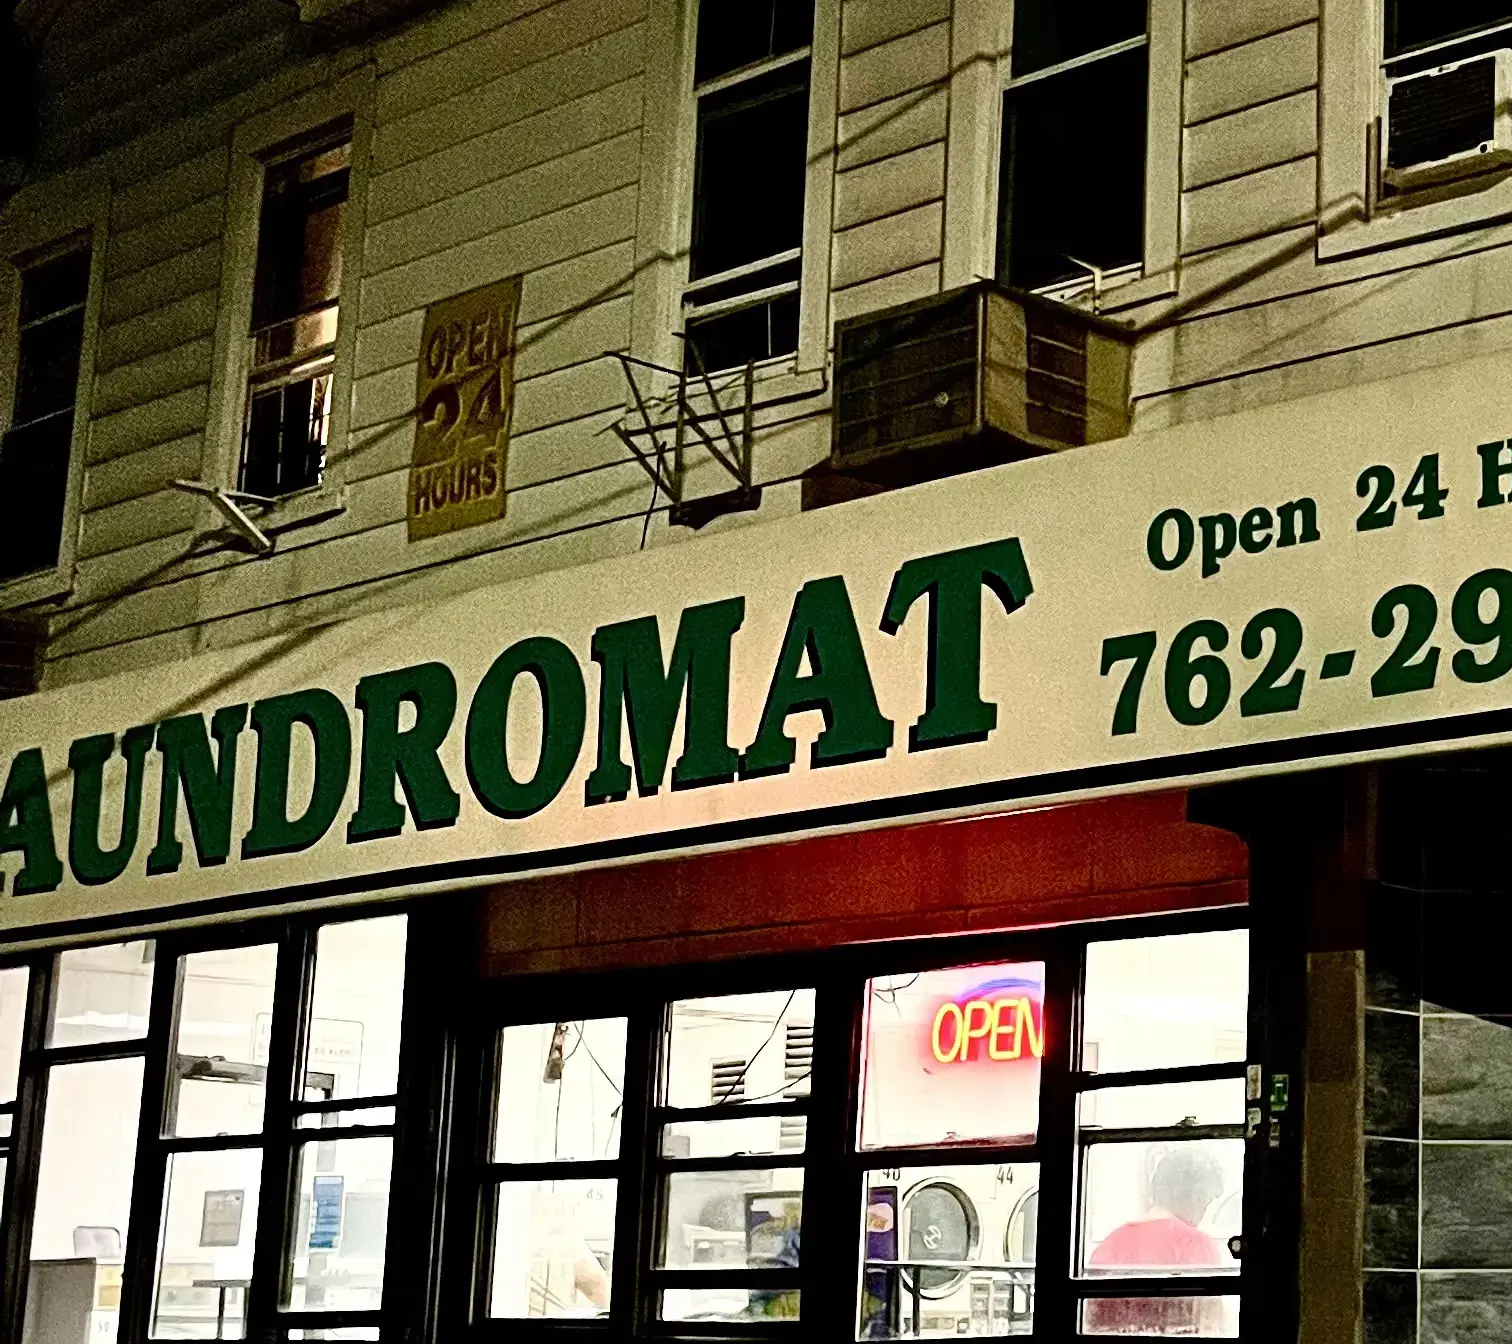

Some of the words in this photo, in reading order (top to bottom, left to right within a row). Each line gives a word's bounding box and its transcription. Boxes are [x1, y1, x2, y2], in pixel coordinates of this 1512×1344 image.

[427, 308, 513, 380] OPEN
[418, 367, 507, 451] 24
[414, 452, 498, 516] HOURS
[1147, 496, 1320, 578] Open
[1356, 453, 1448, 532] 24
[932, 997, 1043, 1063] OPEN
